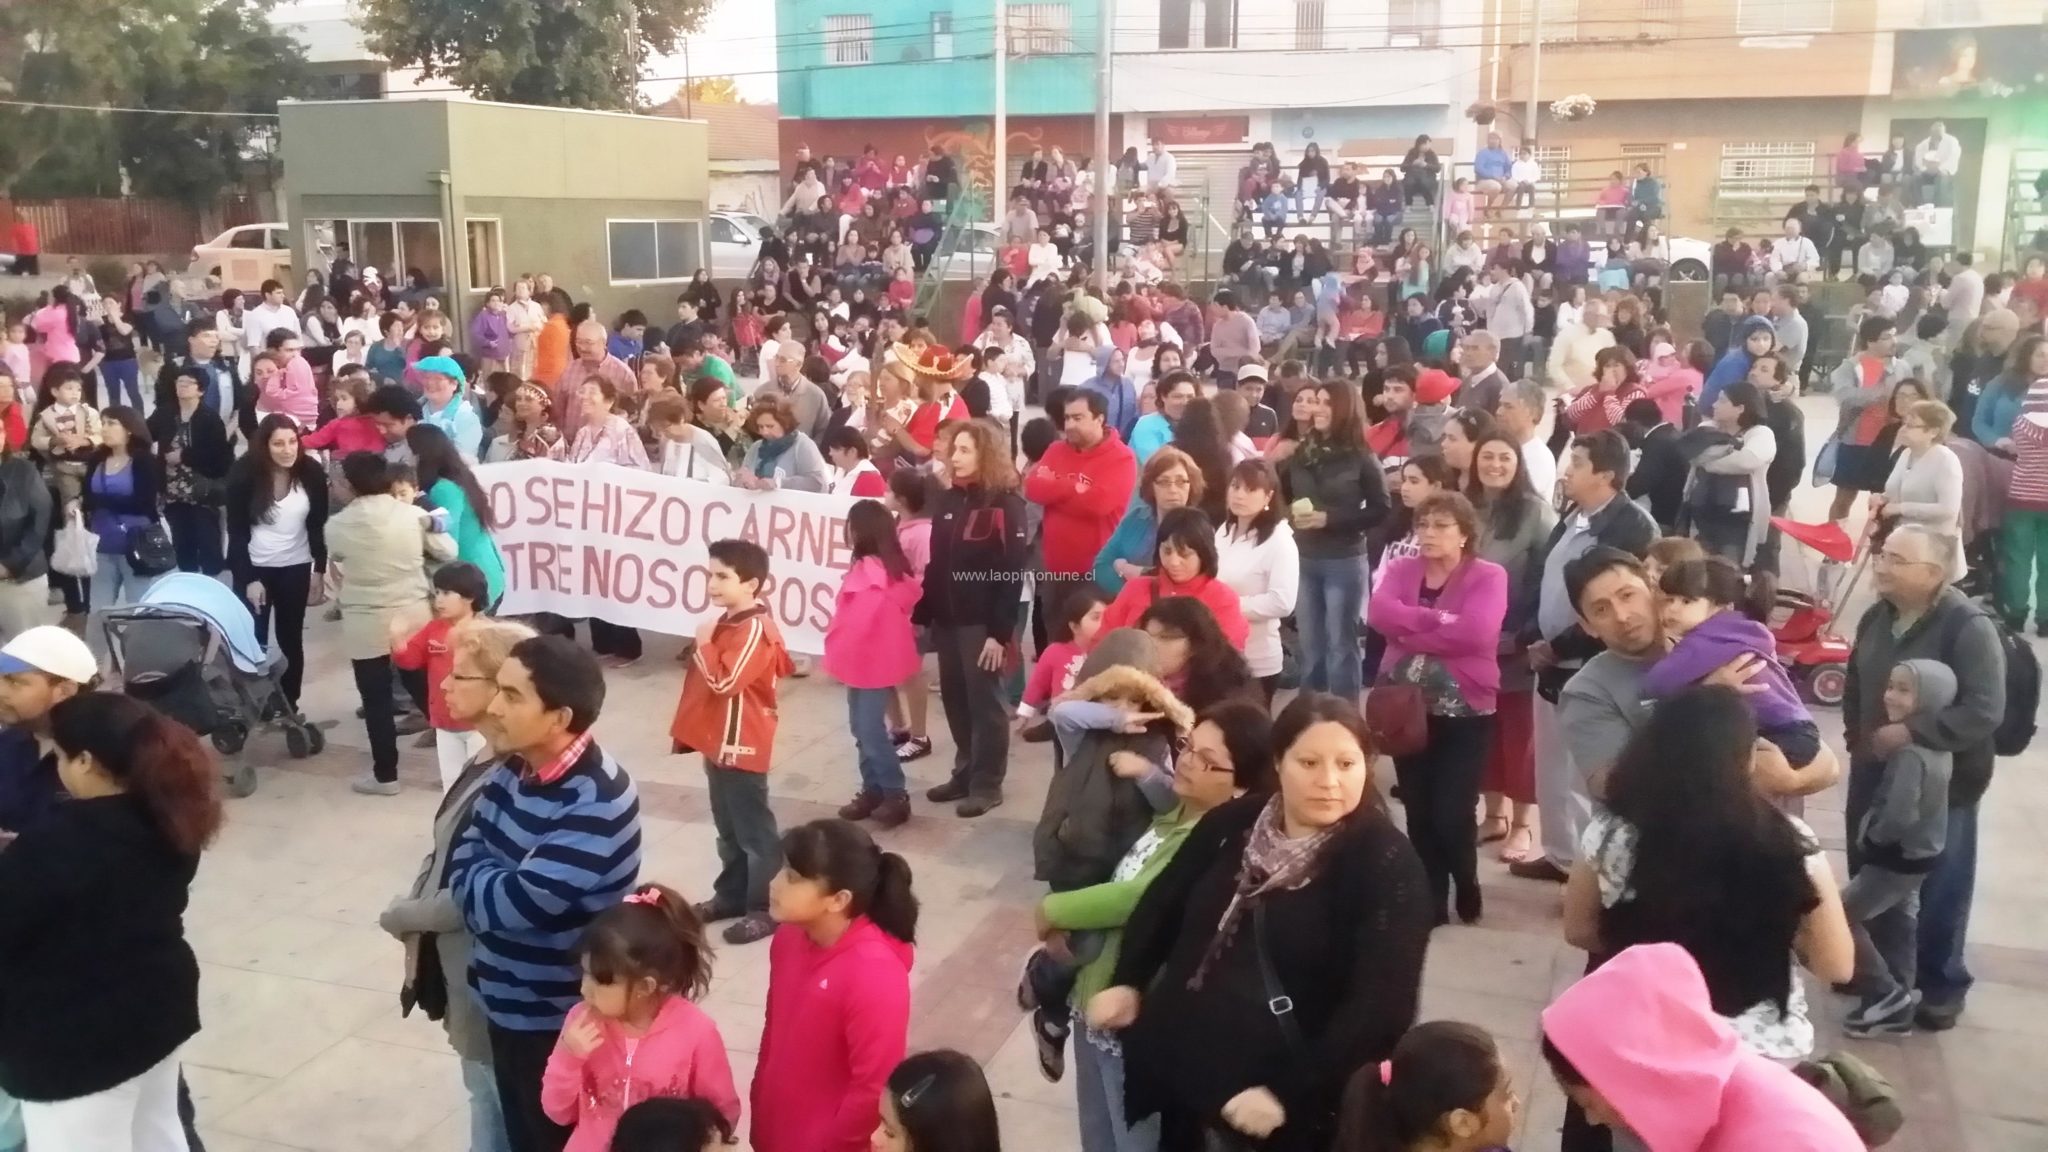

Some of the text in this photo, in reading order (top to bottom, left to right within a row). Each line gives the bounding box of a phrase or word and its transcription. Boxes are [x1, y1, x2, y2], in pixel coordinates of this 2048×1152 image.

[525, 476, 575, 529] SE
[581, 479, 691, 546] HIZO
[702, 502, 851, 570] CARNE
[501, 542, 834, 633] TRE NOSOROS
